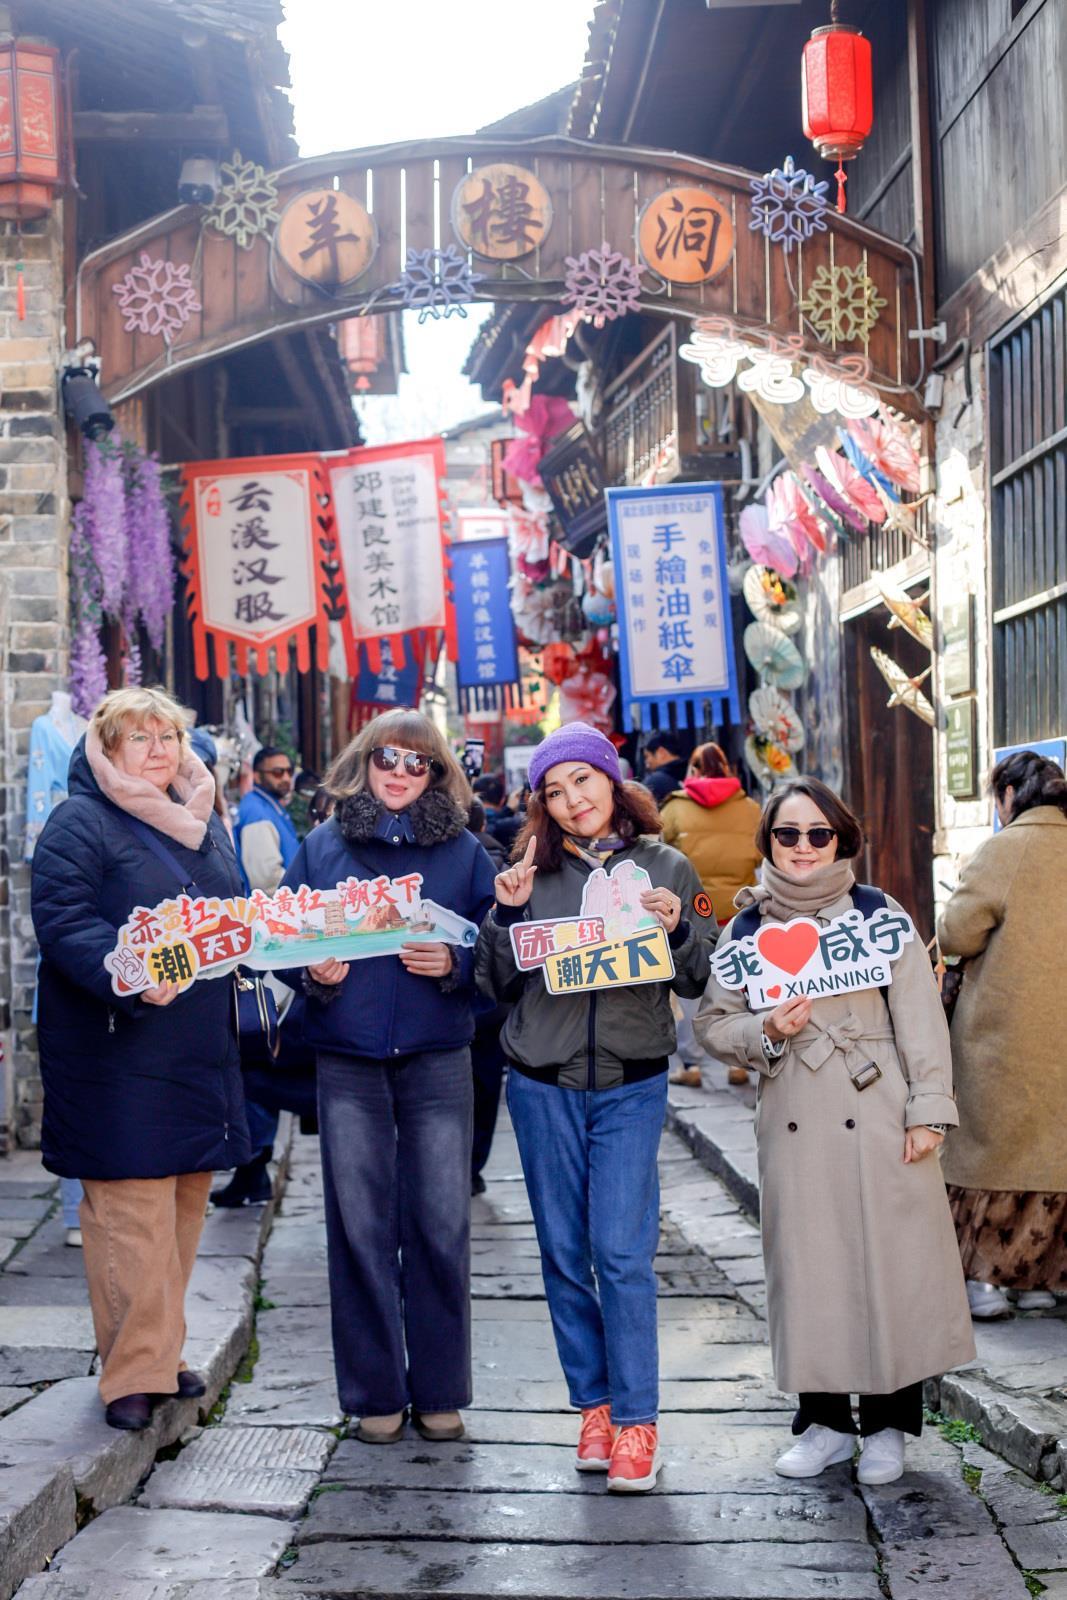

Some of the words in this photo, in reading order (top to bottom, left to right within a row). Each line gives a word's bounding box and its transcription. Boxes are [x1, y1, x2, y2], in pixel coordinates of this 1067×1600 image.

[228, 481, 289, 624] 云溪汉服
[353, 471, 400, 627] 邓建良美术馆
[340, 874, 420, 913] 潮天下
[556, 932, 661, 988] 潮天下
[717, 941, 763, 985] 我
[819, 913, 911, 971] 咸宁
[760, 988, 765, 1003] I
[785, 966, 885, 999] XIANNING
